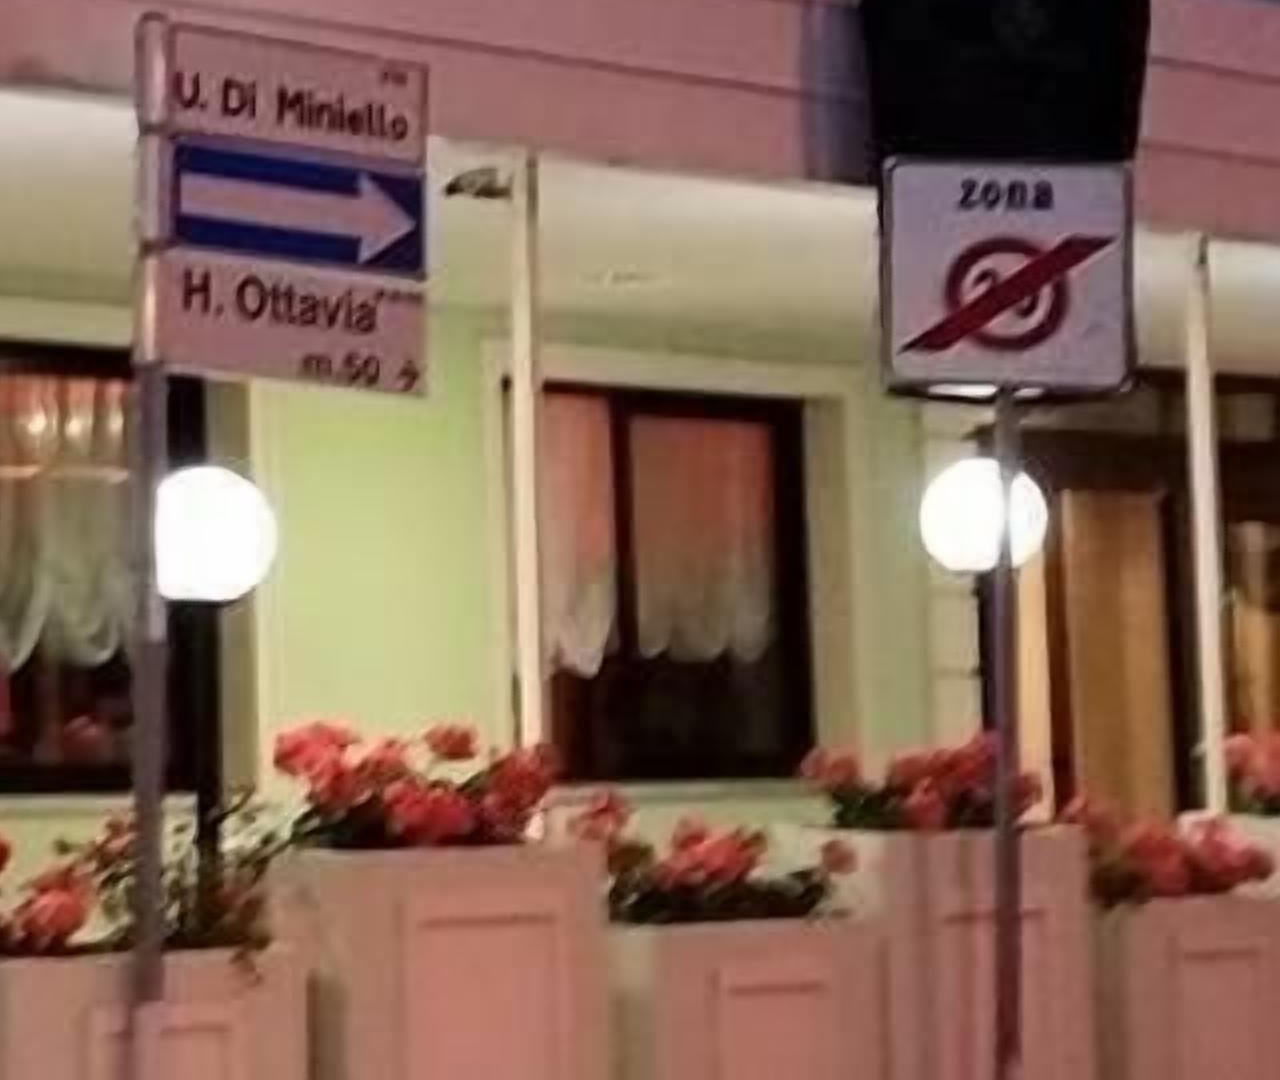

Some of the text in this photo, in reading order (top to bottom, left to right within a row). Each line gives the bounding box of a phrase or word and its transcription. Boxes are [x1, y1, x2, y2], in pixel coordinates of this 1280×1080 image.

[174, 71, 207, 111] U.
[958, 179, 1054, 211] zona
[182, 269, 378, 333] H. Ottavia
